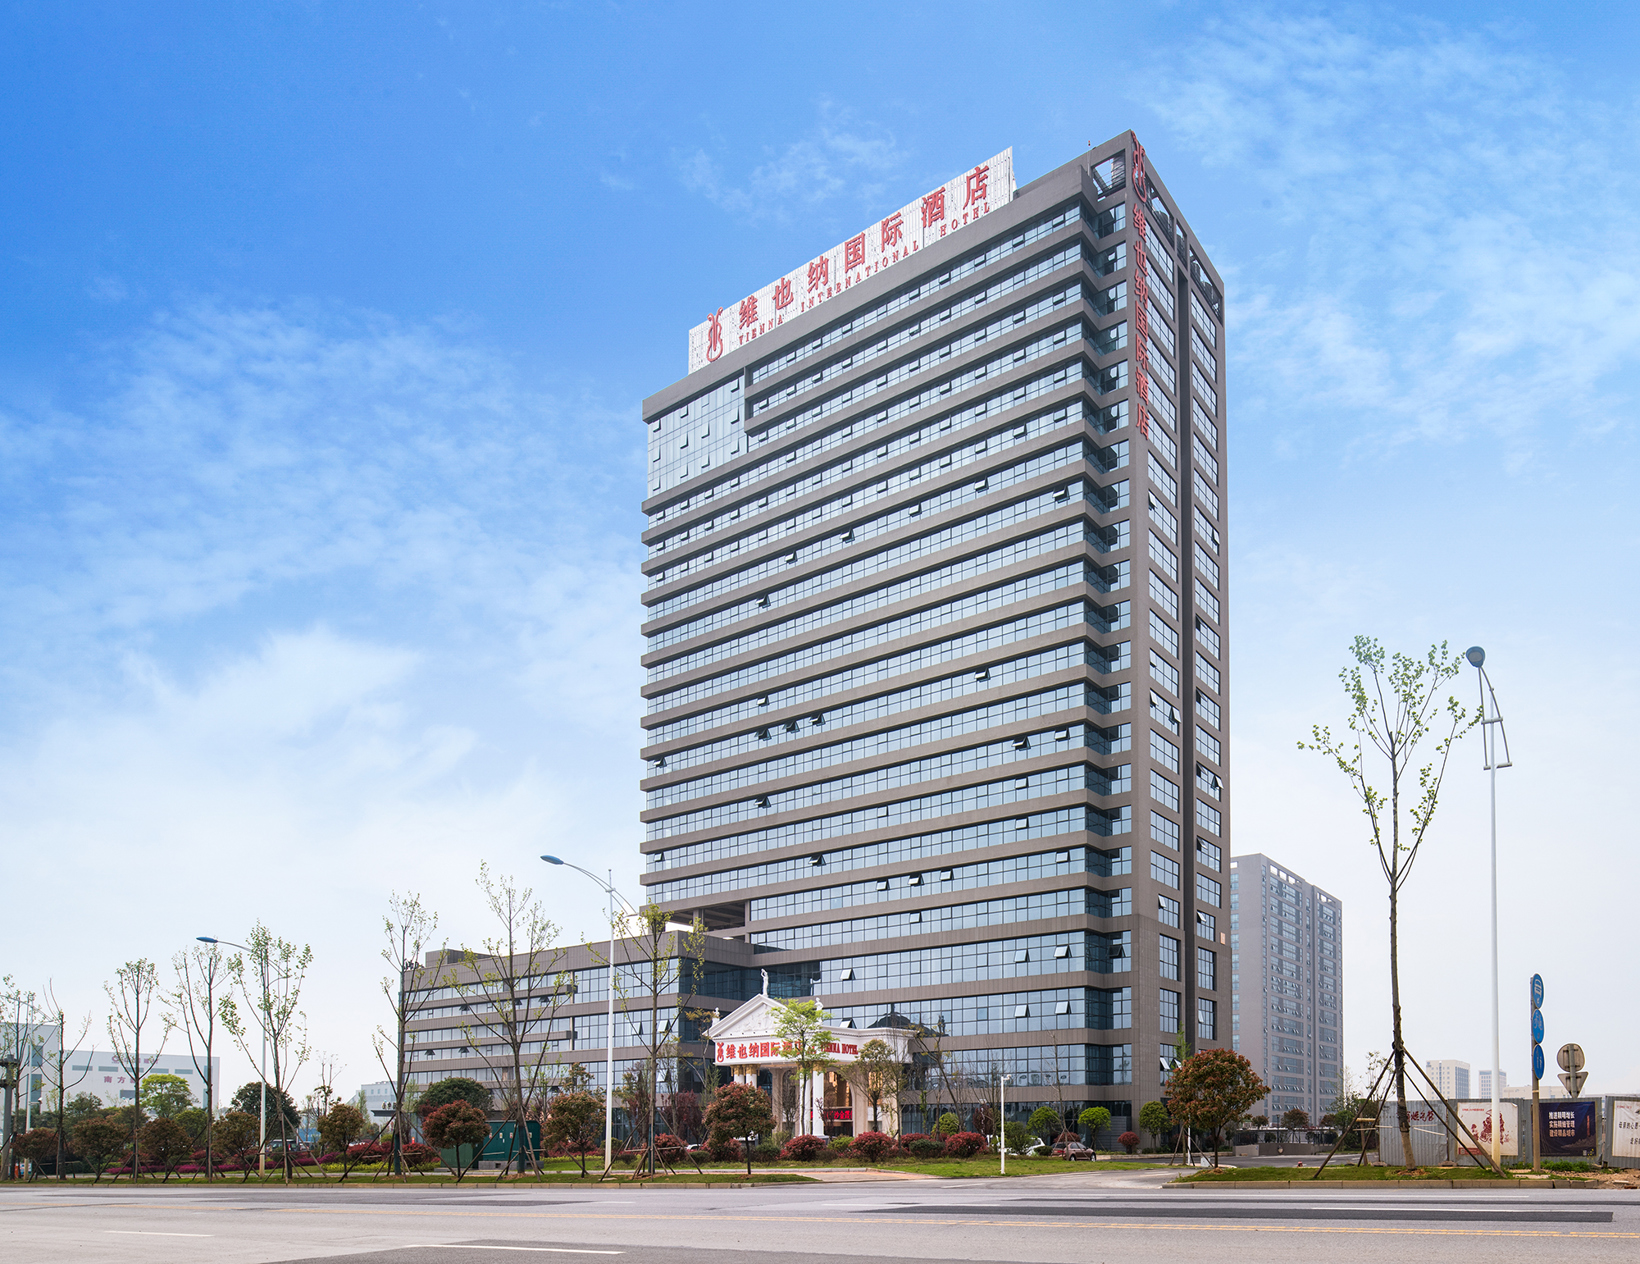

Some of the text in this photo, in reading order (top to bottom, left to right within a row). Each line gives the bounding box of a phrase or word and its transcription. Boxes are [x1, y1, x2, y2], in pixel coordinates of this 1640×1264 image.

[738, 165, 989, 330] 维也纳国际酒店
[738, 201, 990, 345] VIENNA INTERNATIONAL HOTEL
[1133, 203, 1149, 440] 维也纳国际酒店
